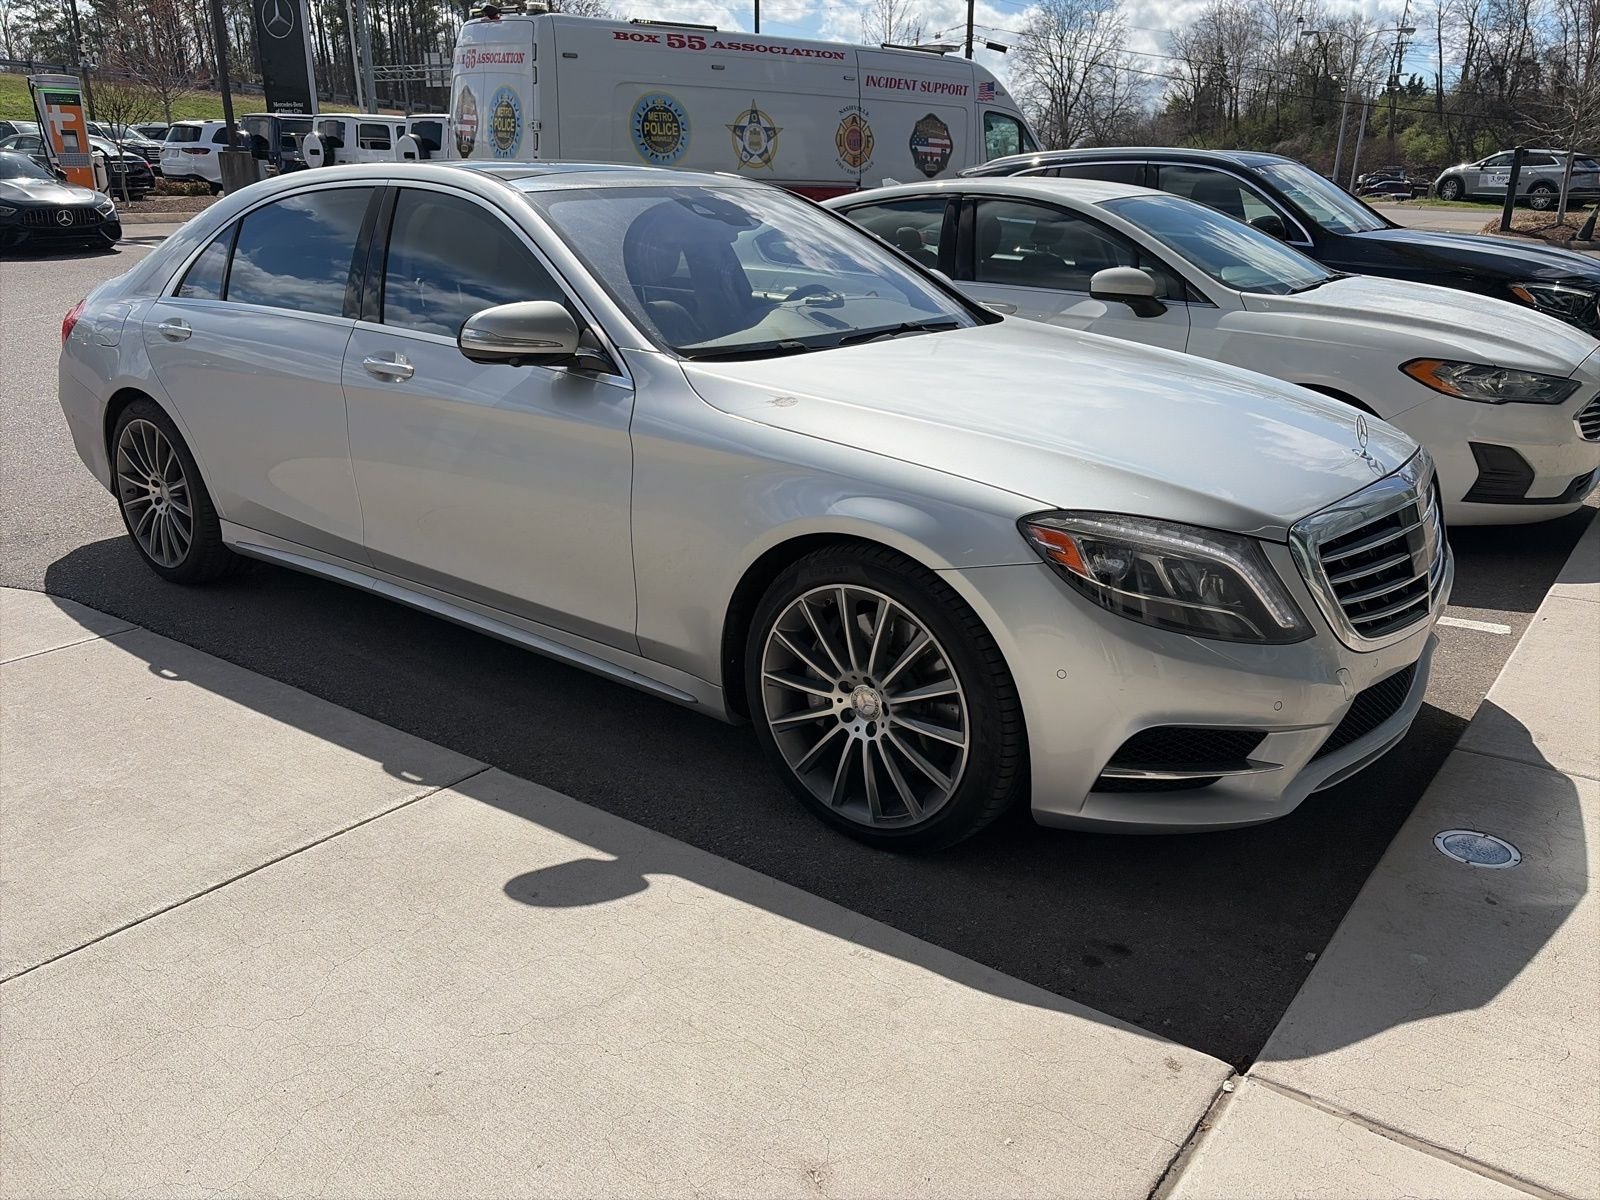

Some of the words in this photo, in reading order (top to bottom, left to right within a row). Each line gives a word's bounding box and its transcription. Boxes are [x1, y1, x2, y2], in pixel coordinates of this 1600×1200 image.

[613, 31, 661, 43] BOX
[666, 33, 707, 51] 55
[710, 40, 846, 60] ASSOCIATION
[465, 49, 477, 69] 55
[477, 52, 526, 65] ASSOCIATION
[865, 75, 918, 91] INCIDENT
[920, 81, 969, 97] SUPPORT
[497, 107, 512, 117] METRO
[647, 111, 673, 121] METRO
[494, 118, 516, 131] POLICE
[644, 122, 679, 136] POLICE
